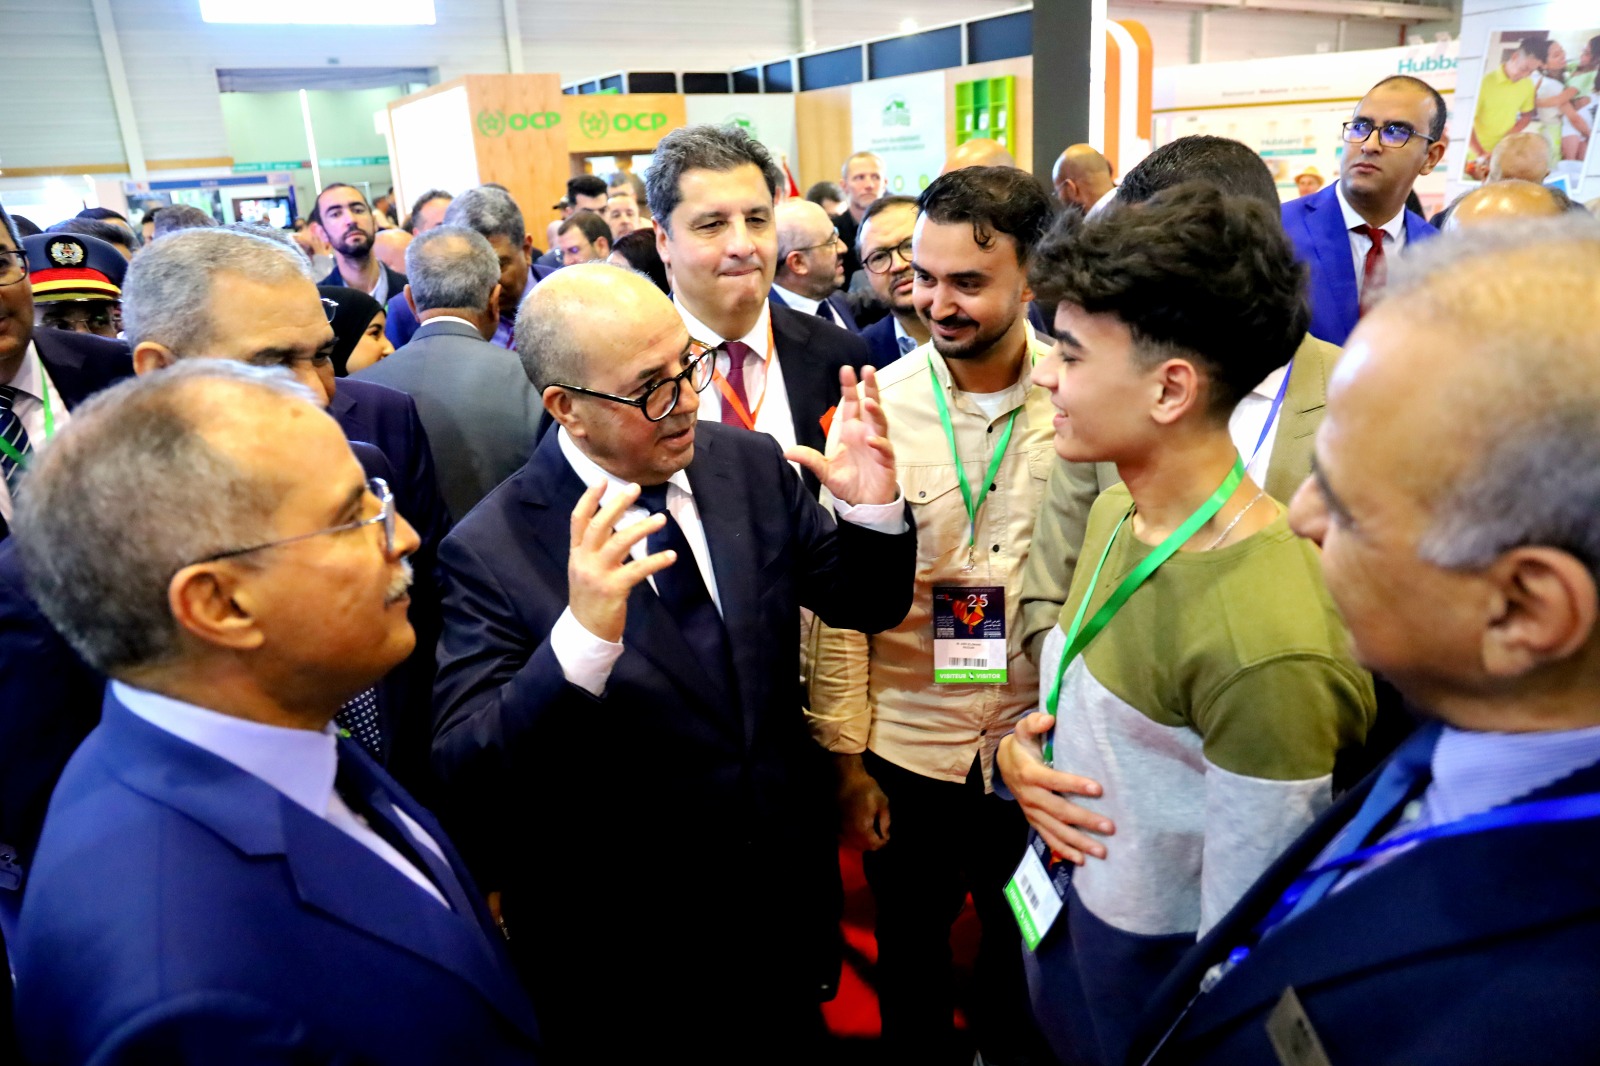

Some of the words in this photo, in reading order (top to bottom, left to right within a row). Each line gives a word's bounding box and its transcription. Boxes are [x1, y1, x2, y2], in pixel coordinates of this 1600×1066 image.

[509, 112, 561, 130] OCP
[613, 113, 667, 131] OCP
[967, 594, 988, 607] 25
